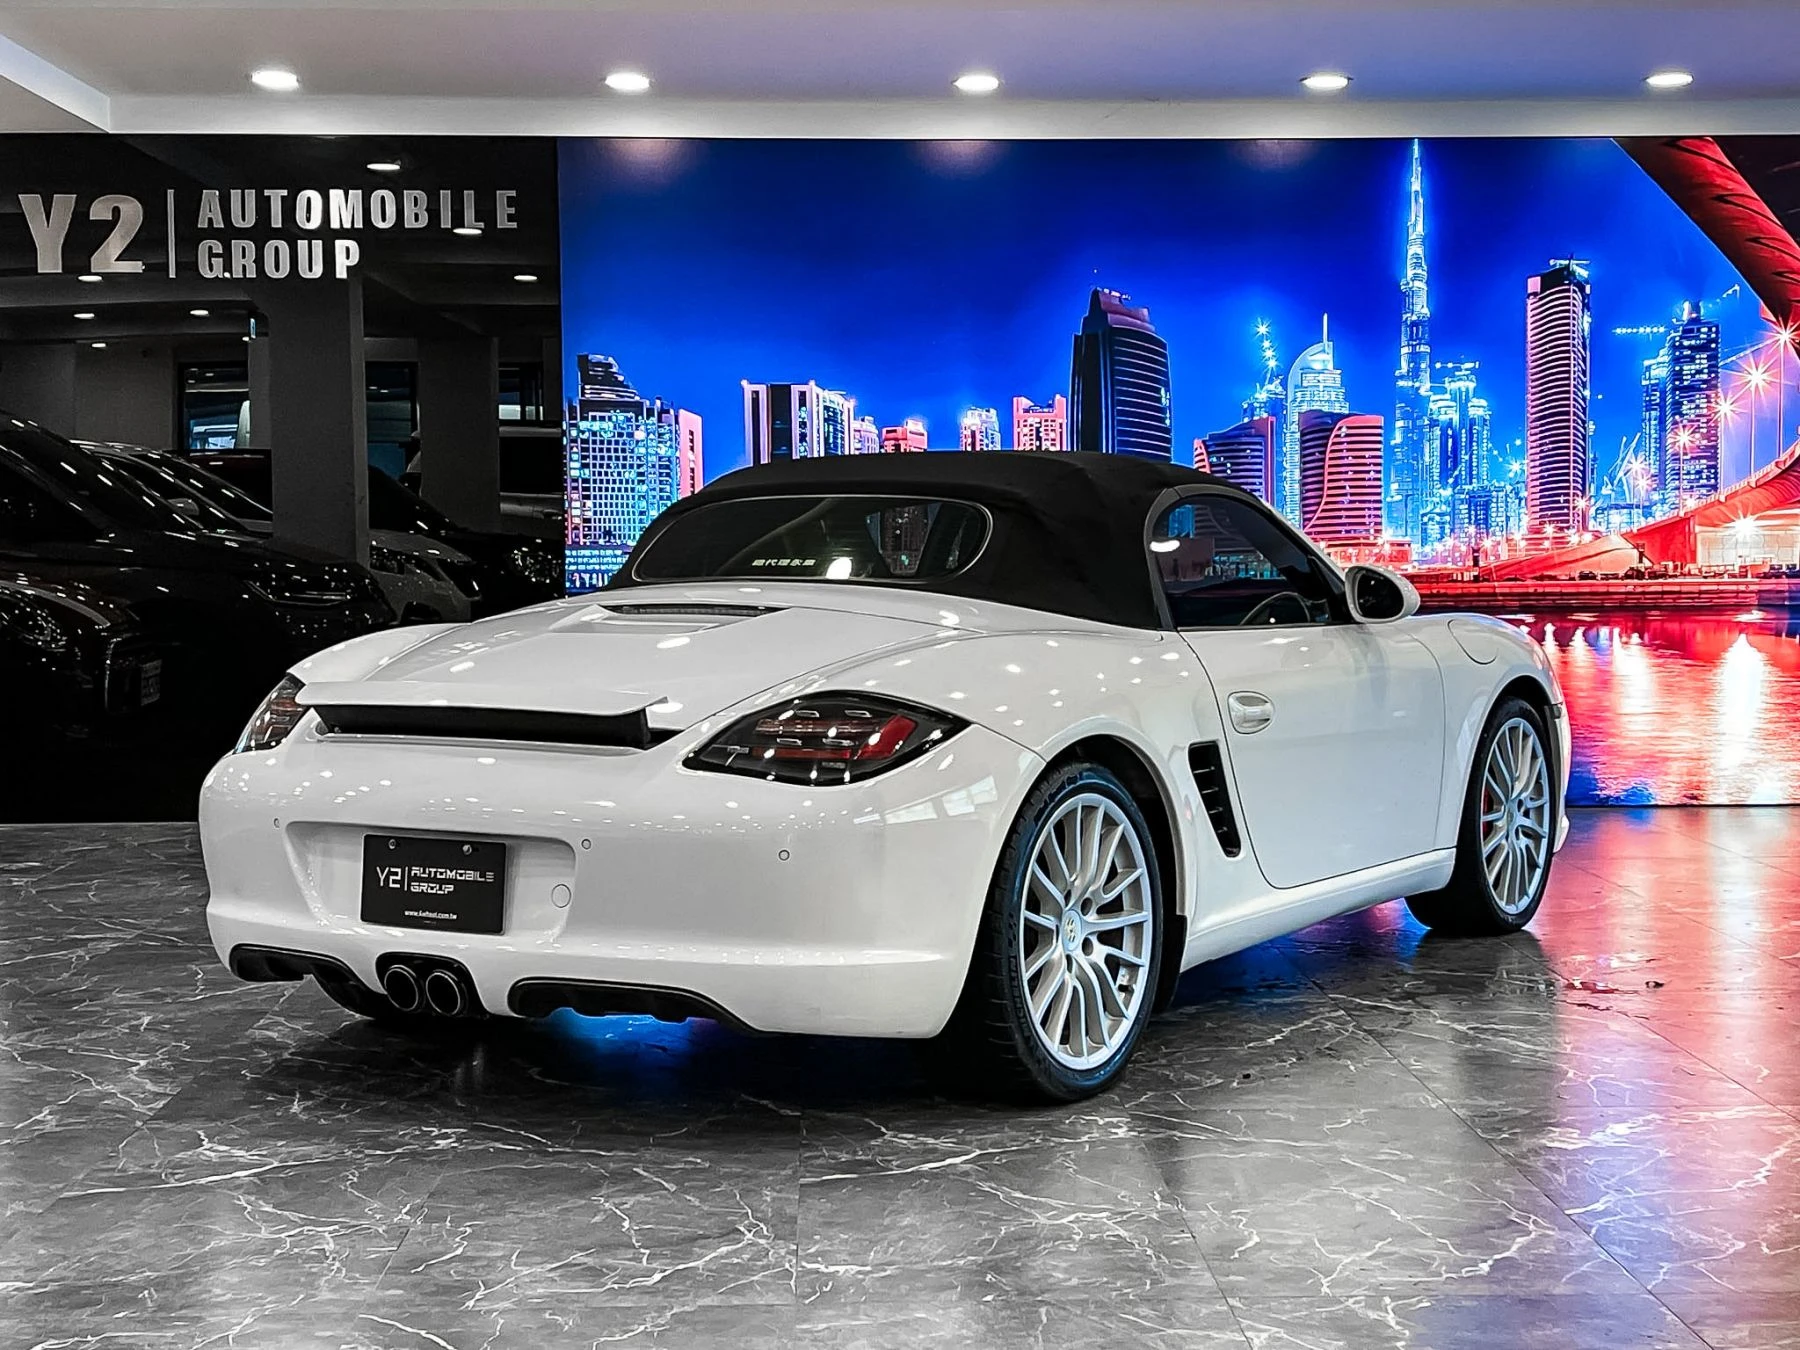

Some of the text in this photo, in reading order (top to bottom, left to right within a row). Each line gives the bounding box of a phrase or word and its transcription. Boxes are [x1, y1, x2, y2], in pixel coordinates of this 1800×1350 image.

[198, 189, 517, 229] AUTOMOBILE
[18, 194, 145, 273] Y2
[198, 239, 360, 279] GROUP
[376, 866, 402, 888] Y2
[410, 866, 495, 882] AUTOMOBILE
[410, 882, 454, 894] GROUP
